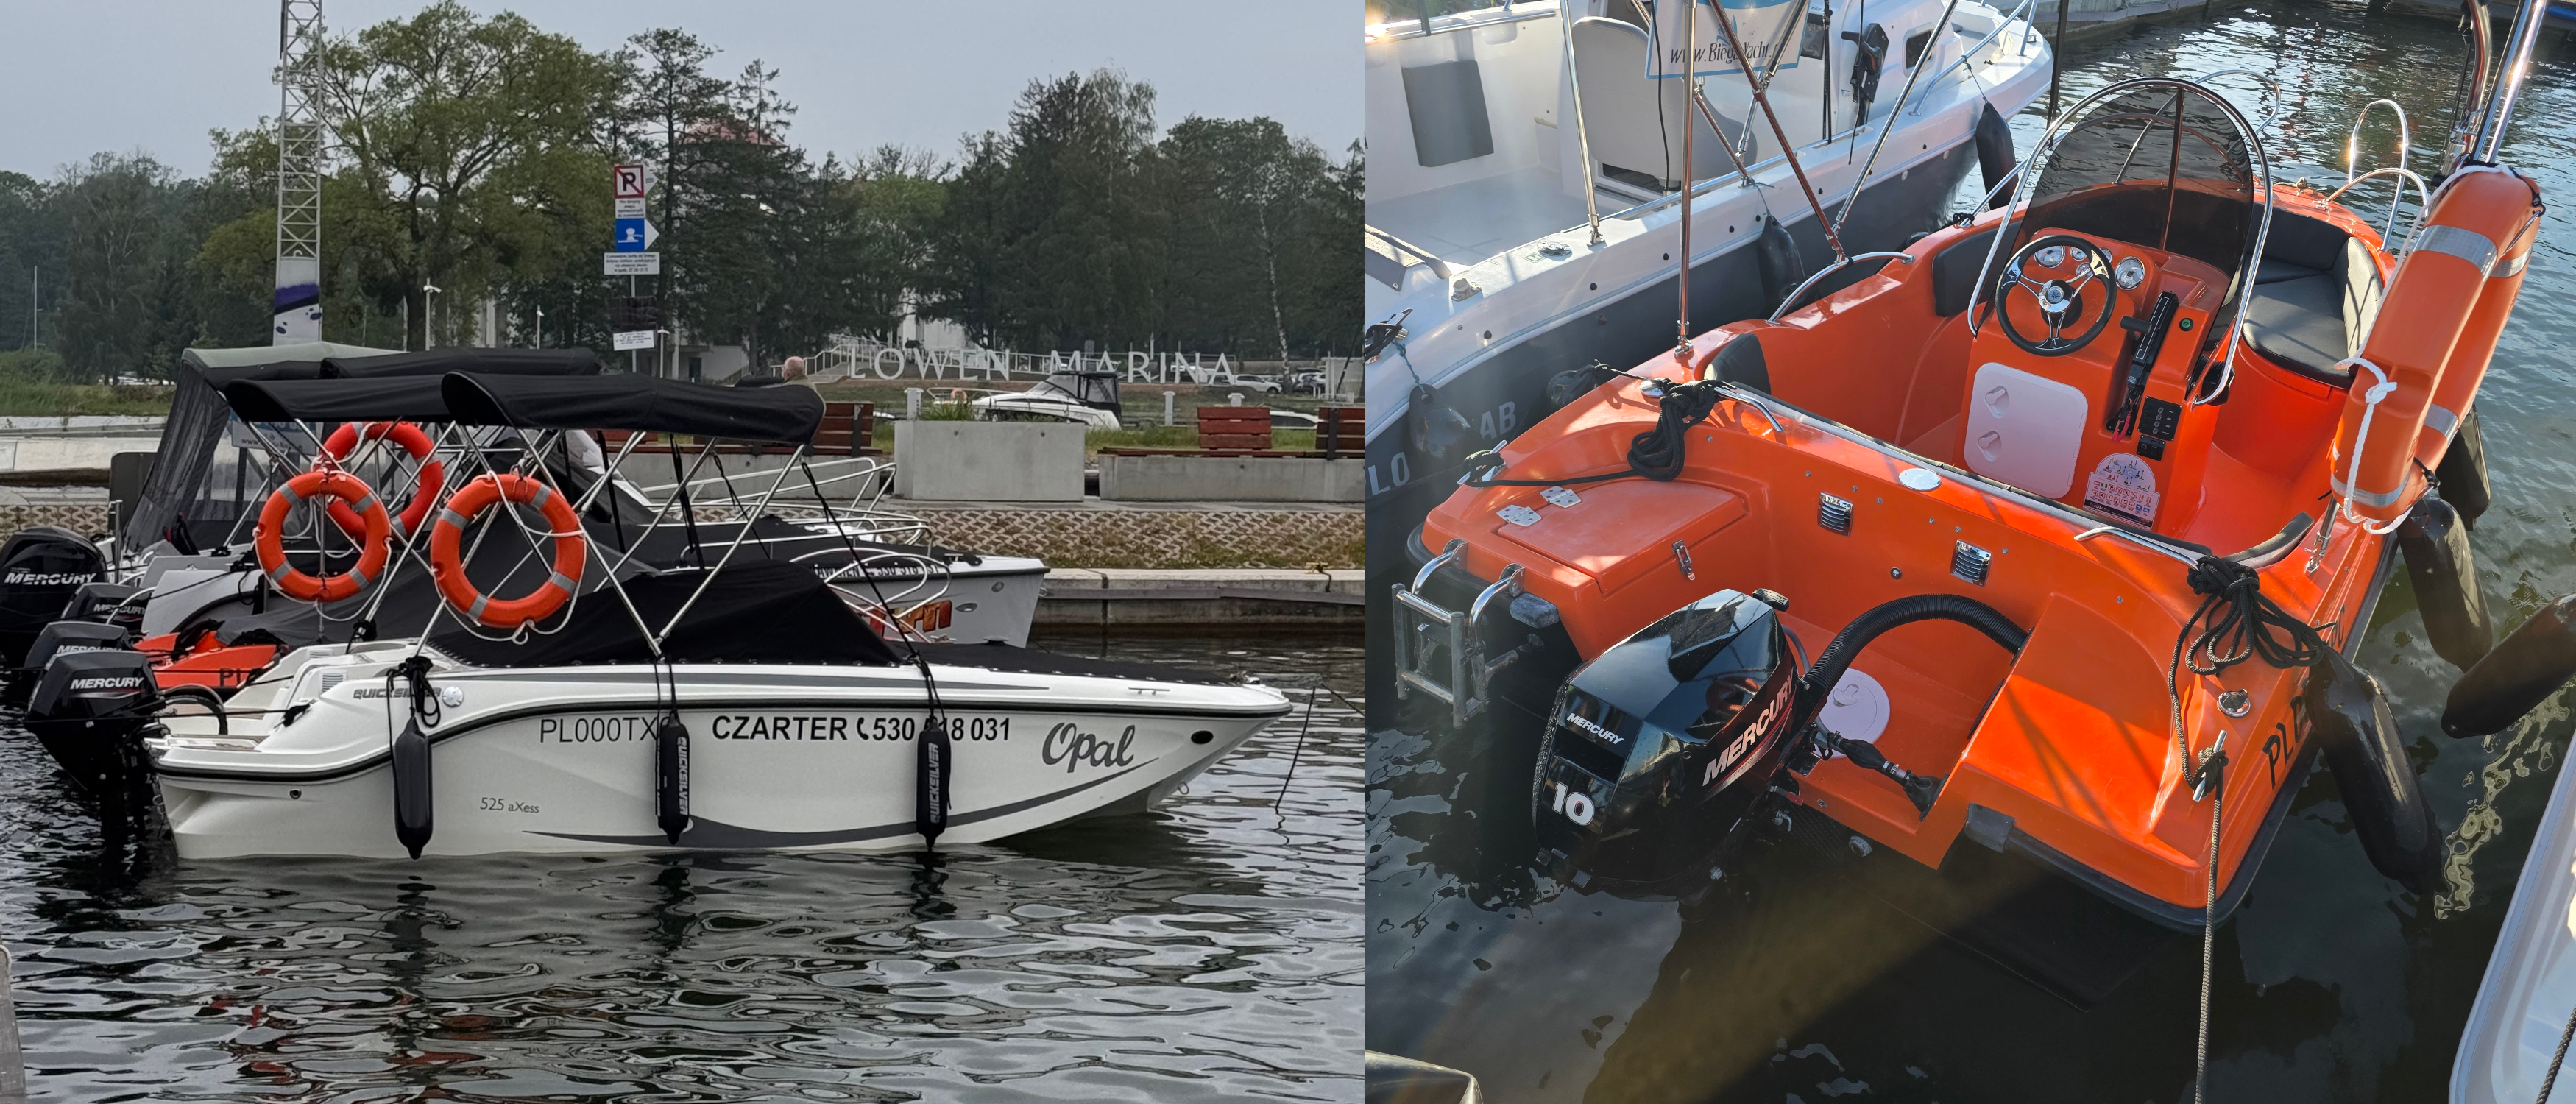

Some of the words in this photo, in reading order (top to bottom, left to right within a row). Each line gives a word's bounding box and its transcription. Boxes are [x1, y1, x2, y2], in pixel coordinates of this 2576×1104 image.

[851, 347, 1009, 381] LOWEN
[1050, 350, 1236, 385] MARINA
[1365, 452, 1410, 495] LO
[1480, 401, 1516, 439] AB
[4, 573, 96, 585] MERCURY
[70, 677, 144, 690] MERCURY
[353, 687, 441, 699] QUICSIR
[712, 716, 847, 740] CZARTER
[872, 718, 915, 740] 530
[971, 718, 1010, 741] 031
[1566, 712, 1624, 745] MERCURY
[1702, 674, 1793, 786] MERCURY
[1042, 722, 1135, 774] Opal
[677, 737, 688, 815] QUICKSILVER
[928, 743, 940, 824] QUICKSILVER
[480, 797, 504, 811] 525
[508, 801, 539, 813] aXess
[1552, 781, 1596, 827] 10
